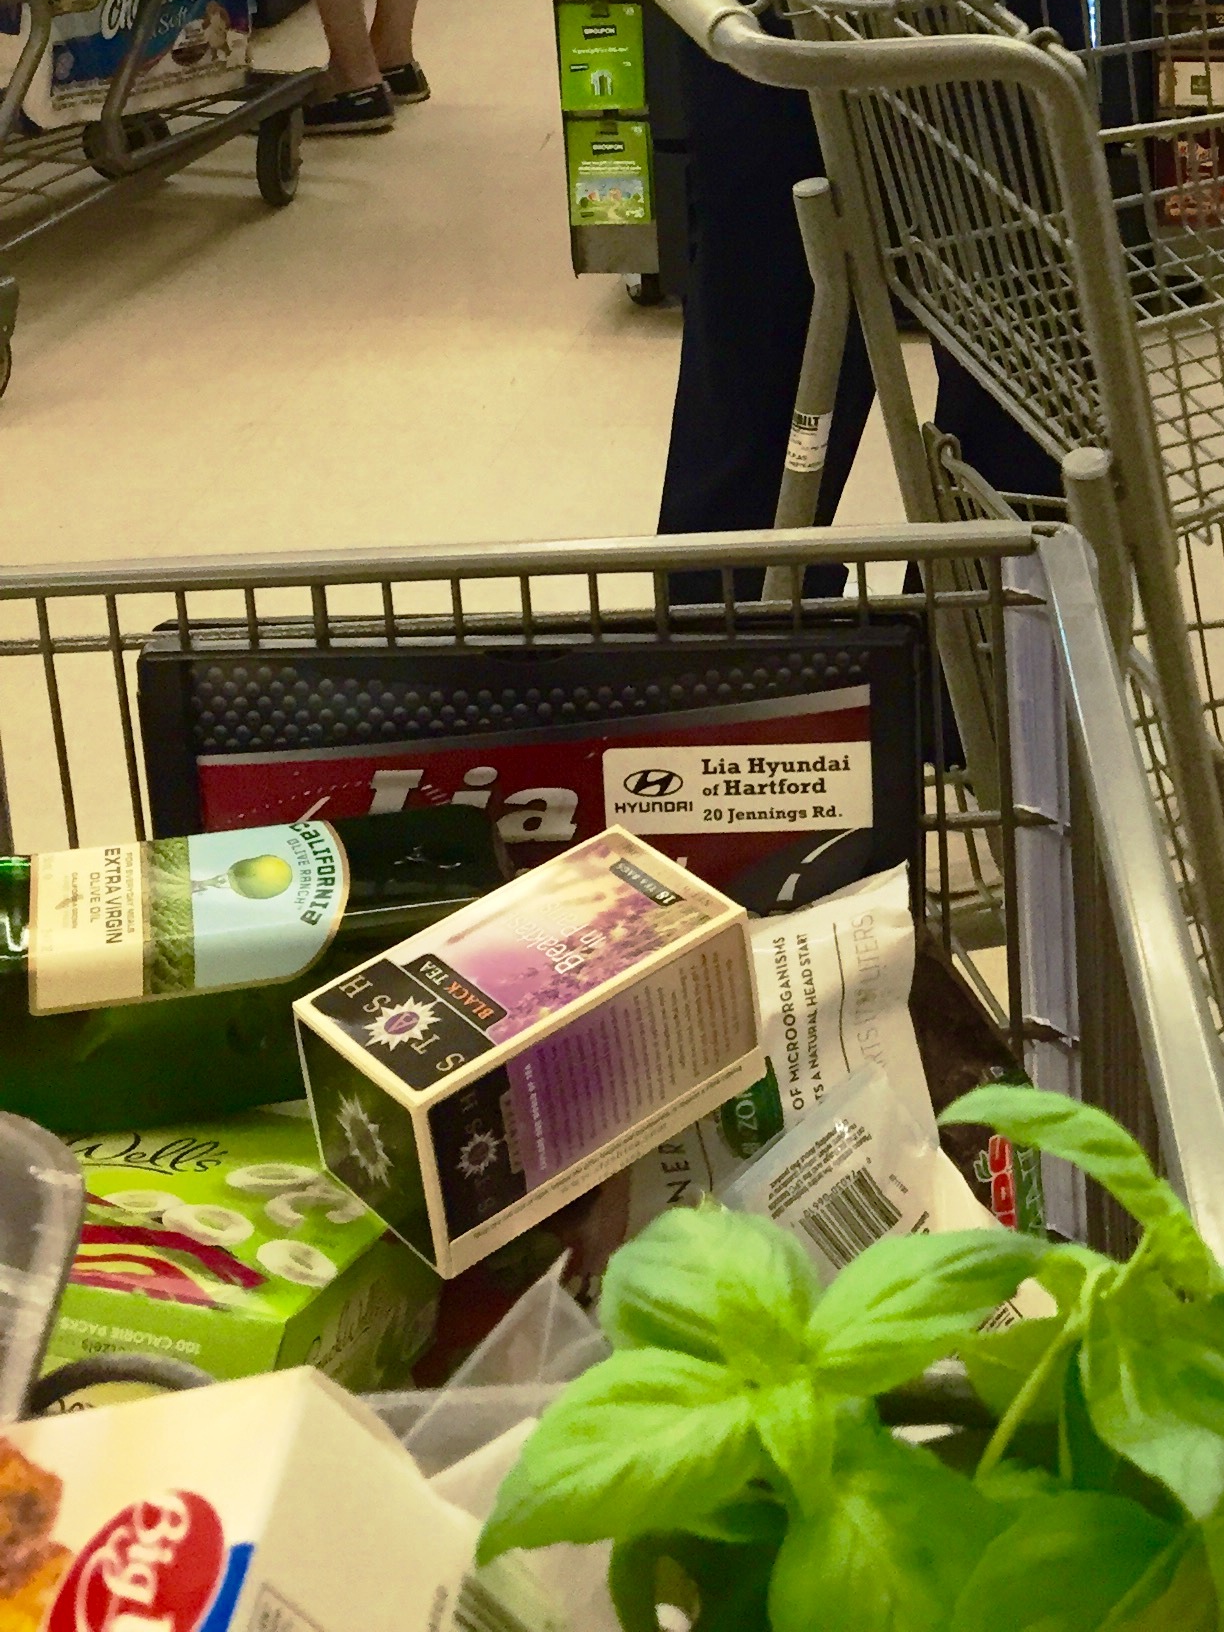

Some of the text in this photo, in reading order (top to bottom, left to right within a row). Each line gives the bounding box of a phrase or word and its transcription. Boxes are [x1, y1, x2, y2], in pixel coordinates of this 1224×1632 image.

[701, 754, 851, 778] Lia Hyundai
[702, 778, 827, 797] of Hartford
[614, 800, 694, 814] HYUNDAI
[703, 805, 843, 824] 20 Jennings Rd.
[125, 852, 134, 868] FOR
[286, 837, 310, 867] OLIVE
[288, 820, 336, 926] CALIFORNIA
[89, 872, 101, 924] OLIVE OIL
[104, 847, 123, 945] EXTRA VIRGIN
[655, 890, 677, 905] 18
[796, 932, 811, 967] START
[419, 960, 495, 1021] BLACK TEA
[800, 971, 818, 1008] HEAD
[773, 936, 806, 1110] OF MICROORGANISMS
[804, 1008, 820, 1070] NATURAL
[110, 1326, 173, 1351] CALORIE
[174, 1338, 202, 1356] 100
